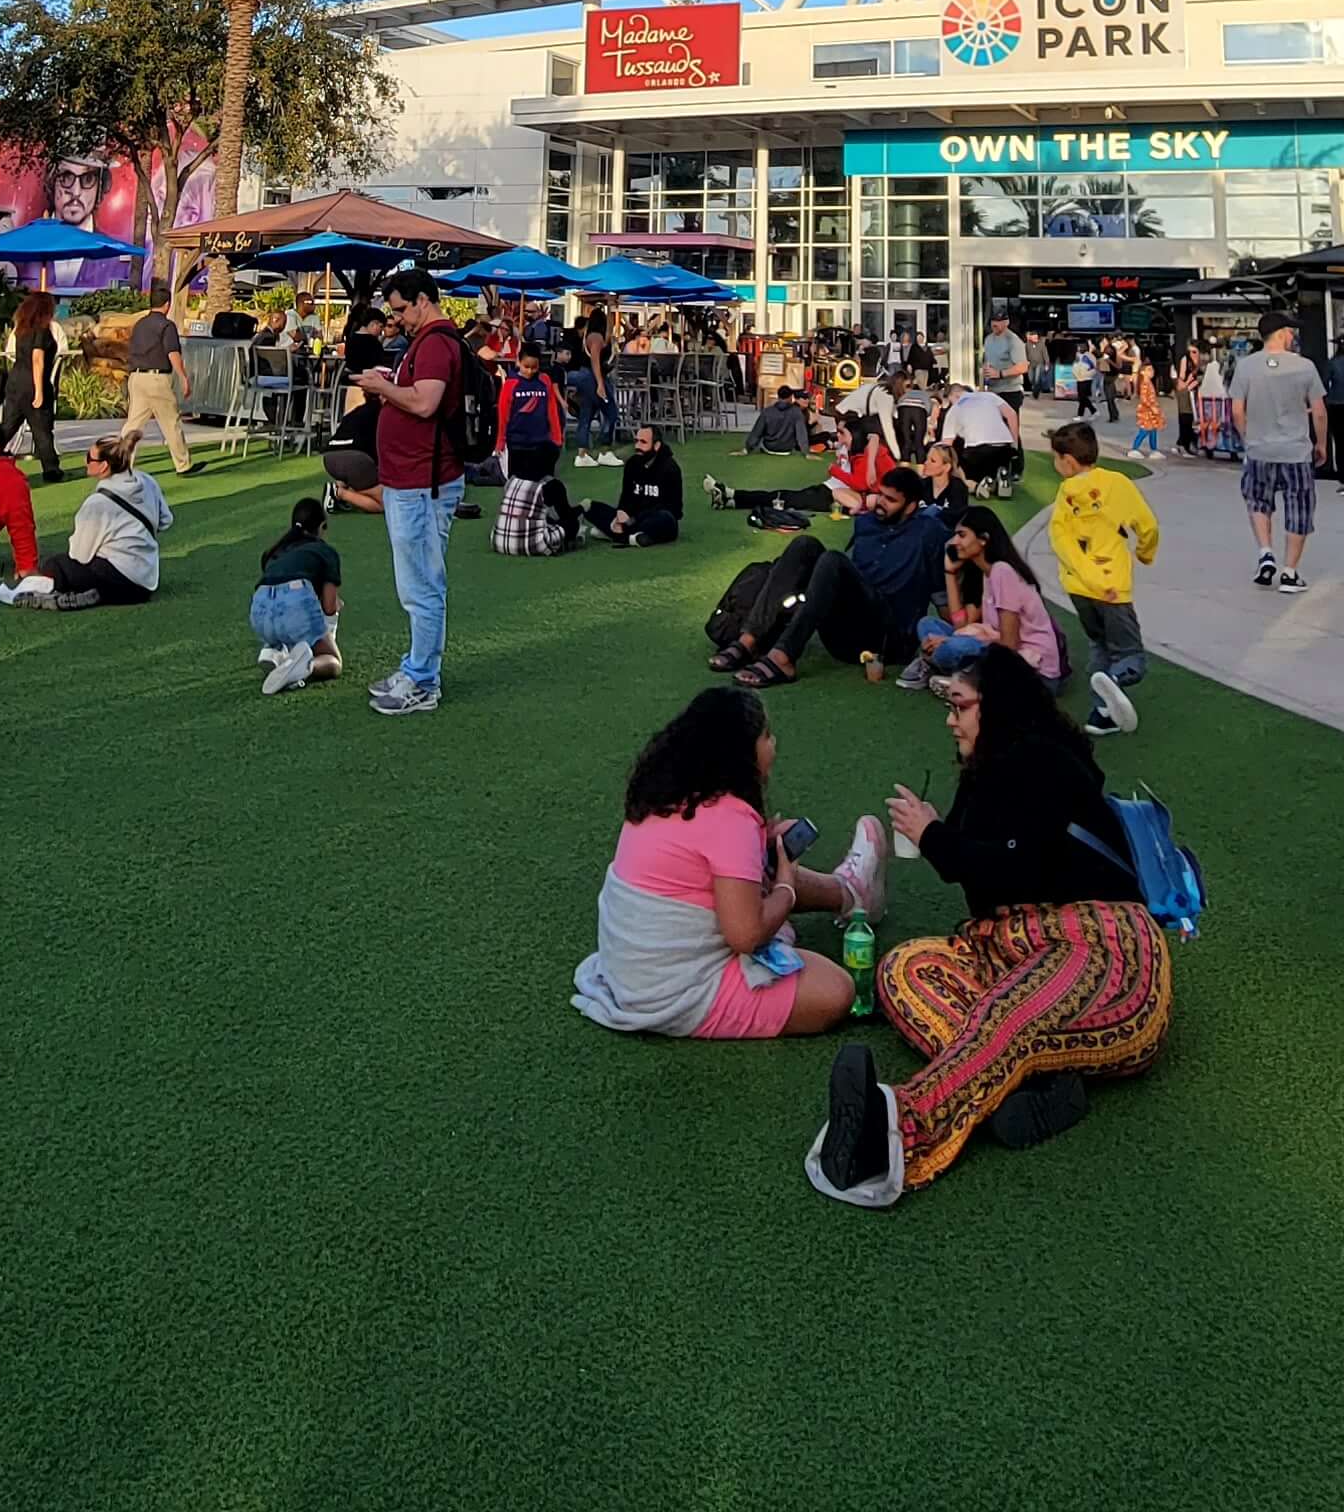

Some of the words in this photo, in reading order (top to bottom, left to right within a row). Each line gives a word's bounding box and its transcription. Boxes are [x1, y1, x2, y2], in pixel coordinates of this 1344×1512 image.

[600, 14, 694, 48] Madame
[1037, 22, 1171, 59] PARK
[602, 43, 706, 87] Tussauds
[644, 78, 686, 87] ORLANDO
[940, 136, 1034, 162] OWN
[1053, 133, 1131, 160] THE
[1149, 131, 1229, 159] SKY
[235, 232, 253, 252] Bar
[427, 242, 451, 260] Bar
